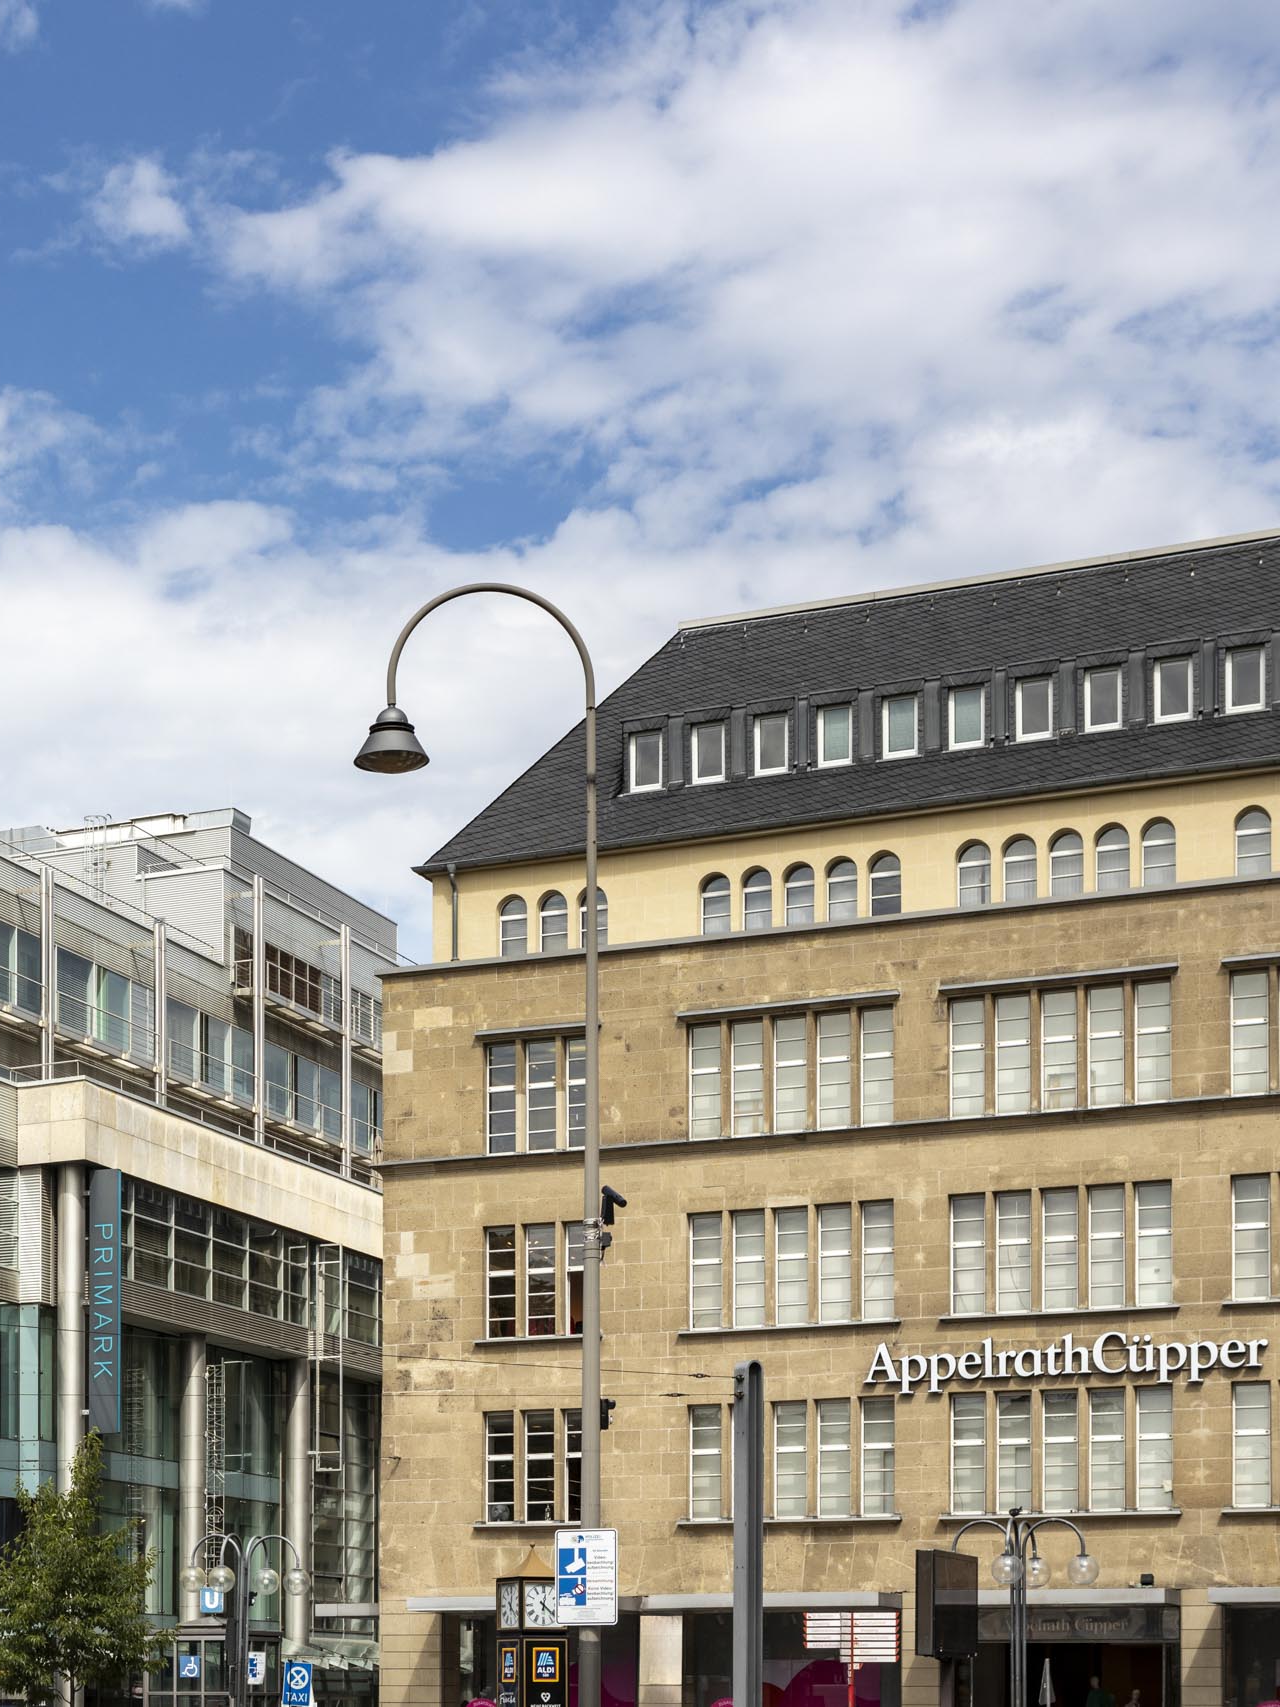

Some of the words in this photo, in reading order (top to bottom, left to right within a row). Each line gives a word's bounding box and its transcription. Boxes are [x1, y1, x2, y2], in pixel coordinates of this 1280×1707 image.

[94, 1223, 114, 1379] PRIMARK
[863, 1331, 1269, 1395] AppelrathCüpper
[204, 1591, 220, 1609] U
[1074, 1617, 1129, 1635] Cüpper
[536, 1666, 555, 1674] ALDI
[286, 1692, 308, 1703] TAXI
